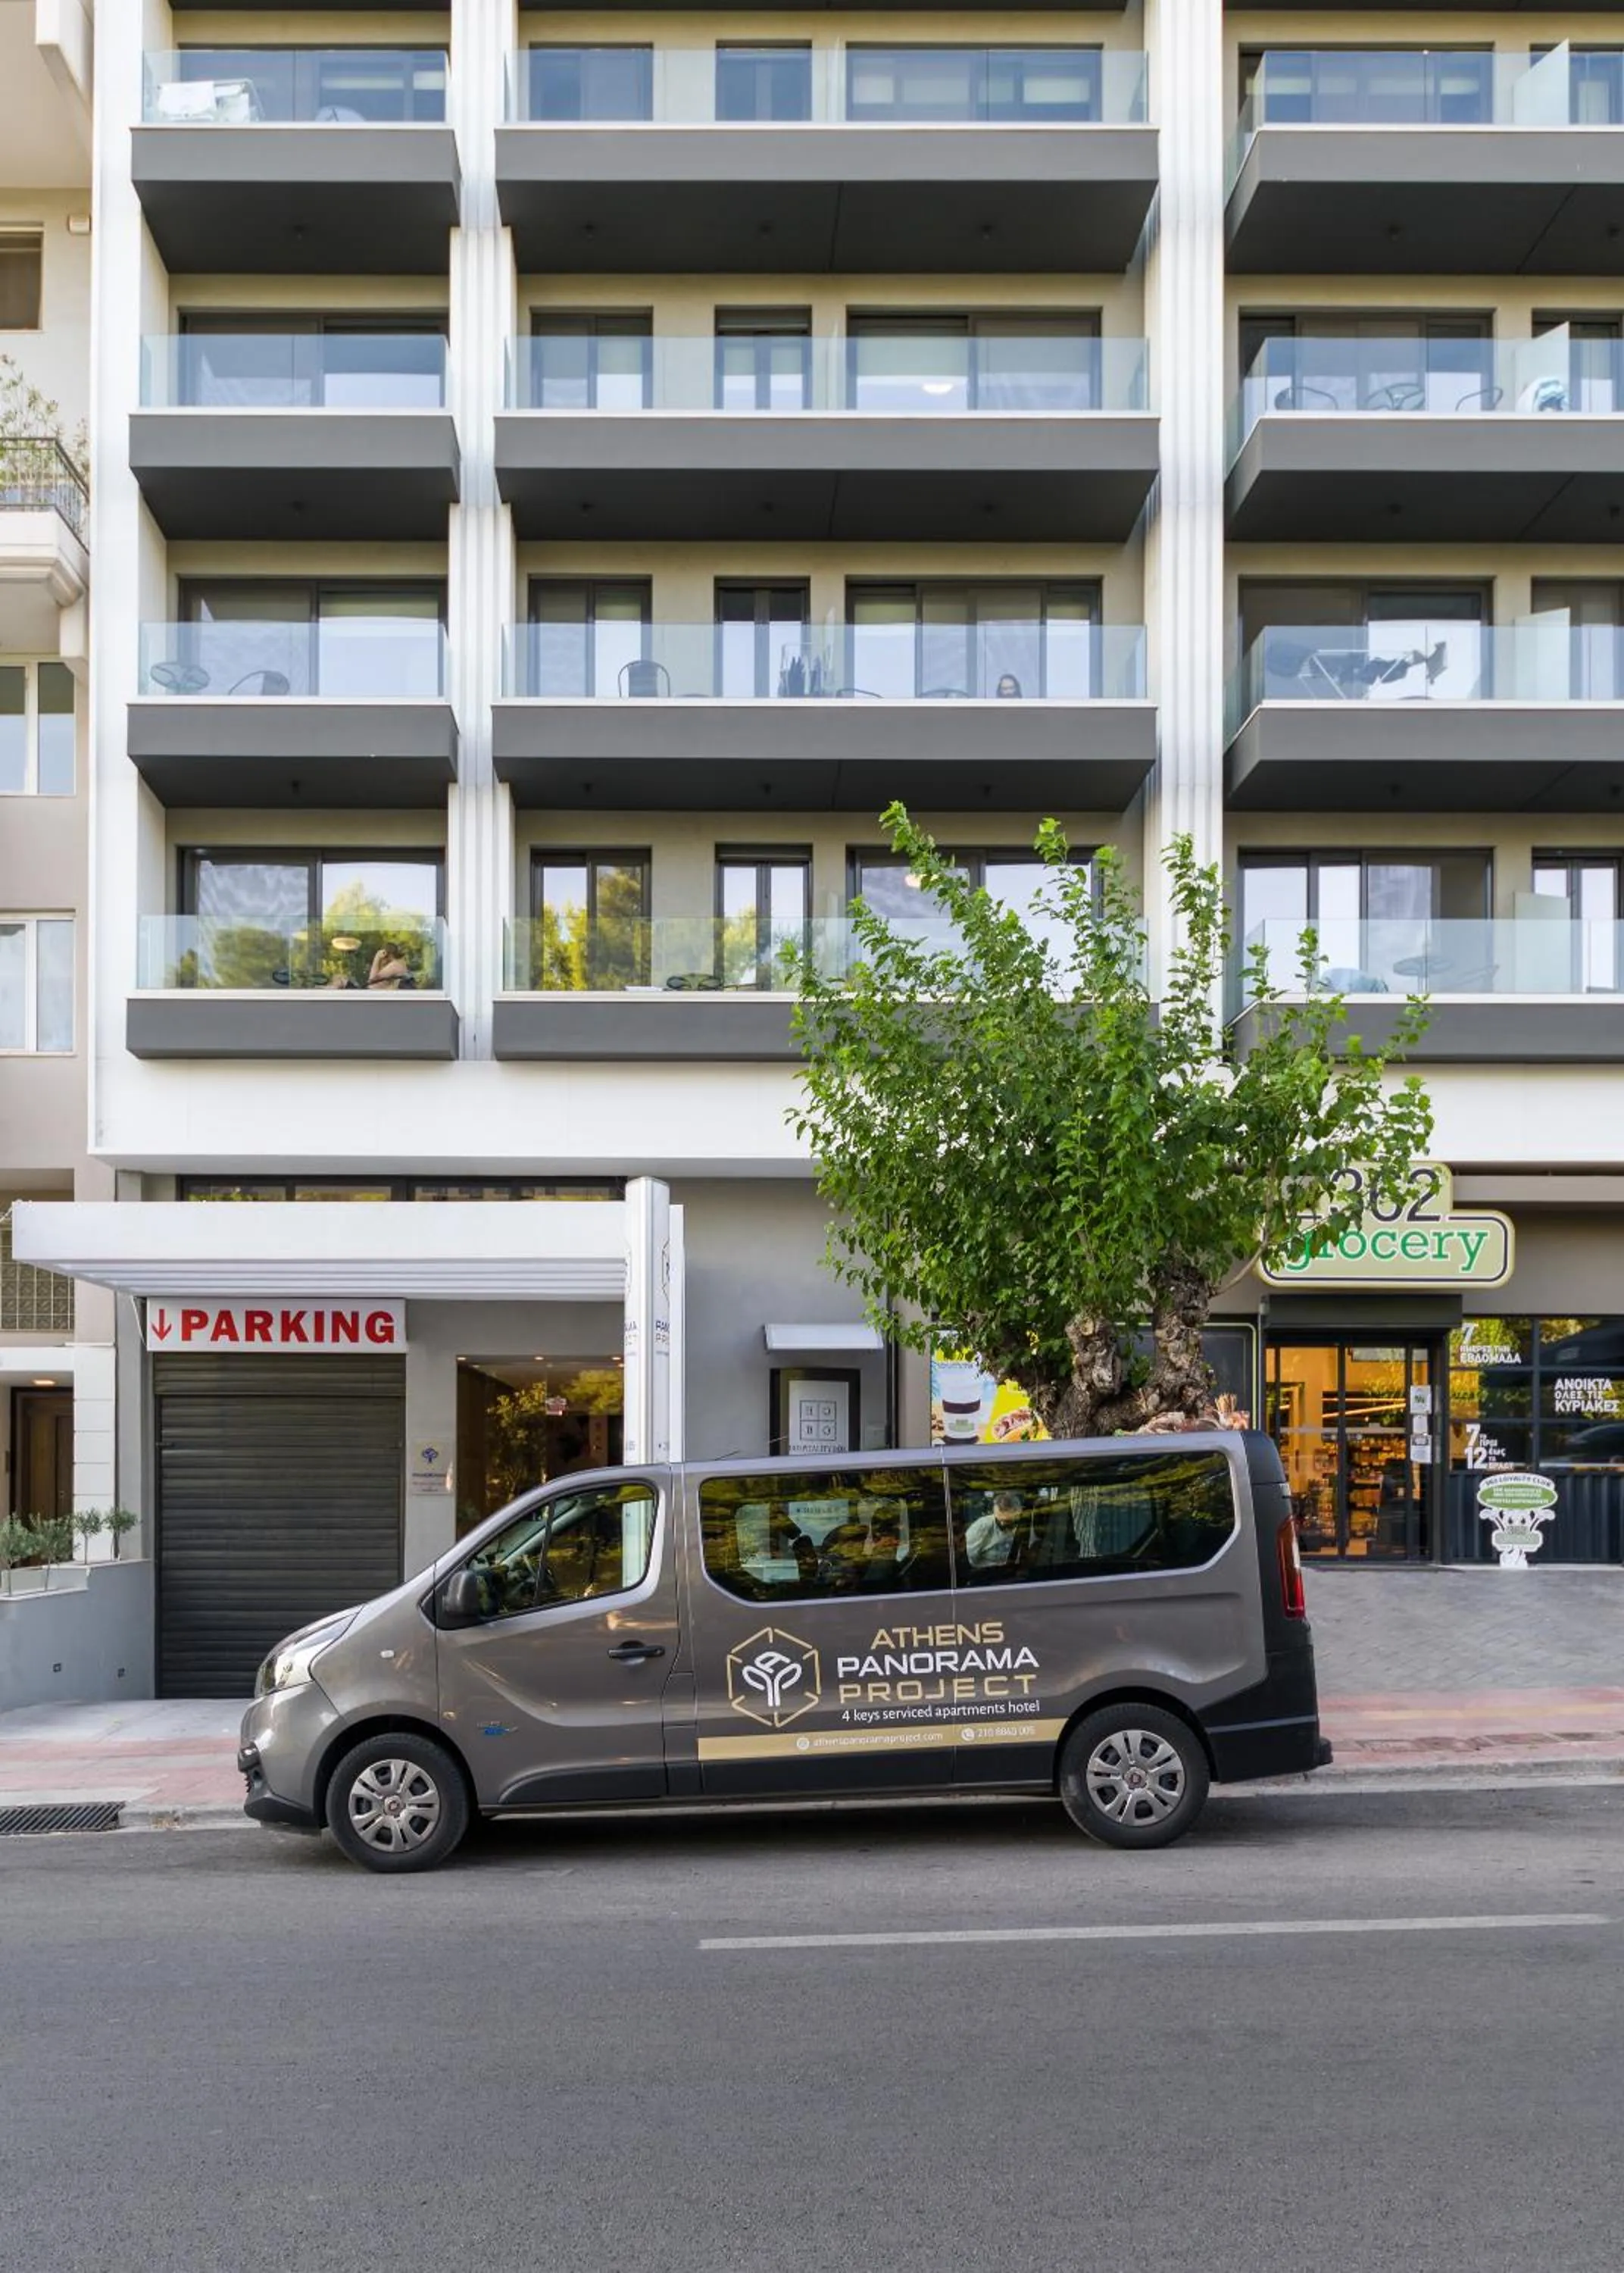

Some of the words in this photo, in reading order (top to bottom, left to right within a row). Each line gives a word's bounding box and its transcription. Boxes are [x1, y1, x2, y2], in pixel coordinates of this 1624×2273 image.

[181, 1308, 395, 1343] PARKING
[1462, 1323, 1479, 1344] 7
[1554, 1378, 1613, 1390] ΑΝΟΙΚΤΑ
[1554, 1390, 1582, 1399] ΟΛΕΣ
[1555, 1399, 1620, 1412] ΚΥΡΙΑΚΕΣ
[1466, 1424, 1481, 1447] 7
[1464, 1447, 1487, 1469] 12
[871, 1621, 1005, 1650] ATHENS
[837, 1646, 1040, 1678] PANORAMA
[839, 1674, 1037, 1704] PROJECT
[842, 1710, 851, 1721] 4
[854, 1709, 881, 1724] keys
[882, 1705, 932, 1720] serviced
[935, 1703, 1005, 1719] apartments
[1008, 1699, 1040, 1713] hotel
